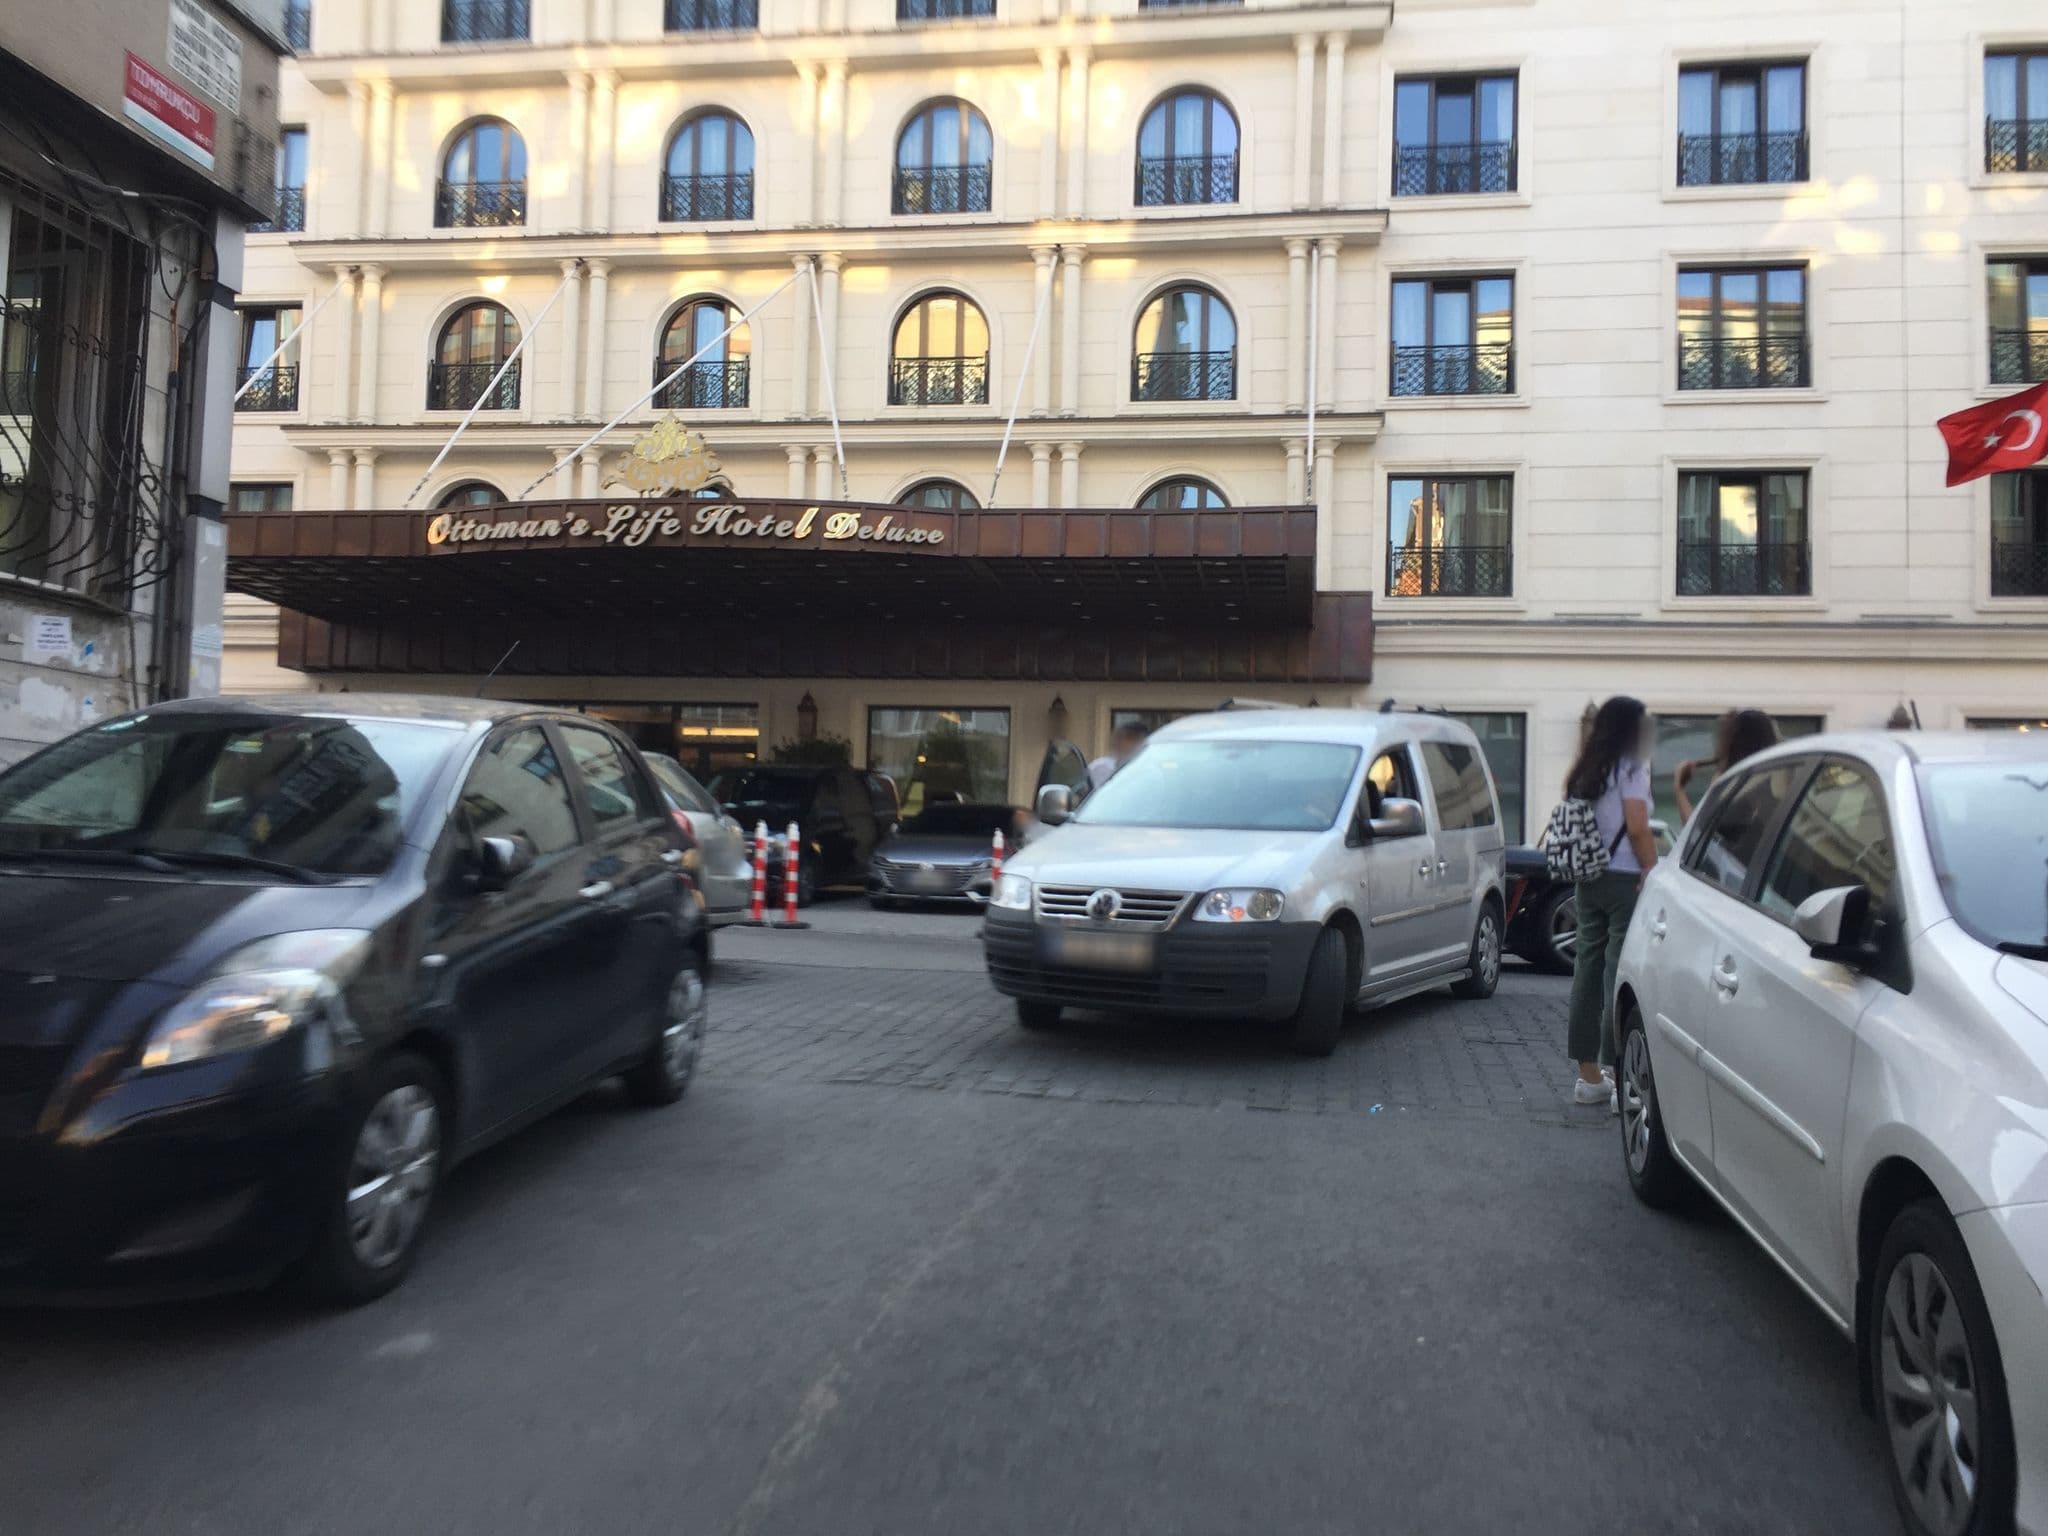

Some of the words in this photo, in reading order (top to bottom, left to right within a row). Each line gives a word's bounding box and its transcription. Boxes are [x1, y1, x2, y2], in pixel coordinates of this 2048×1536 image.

[427, 511, 590, 545] Ottoman's
[593, 505, 682, 547] Life
[689, 504, 820, 539] Hotel
[823, 511, 945, 545] Deluxe
